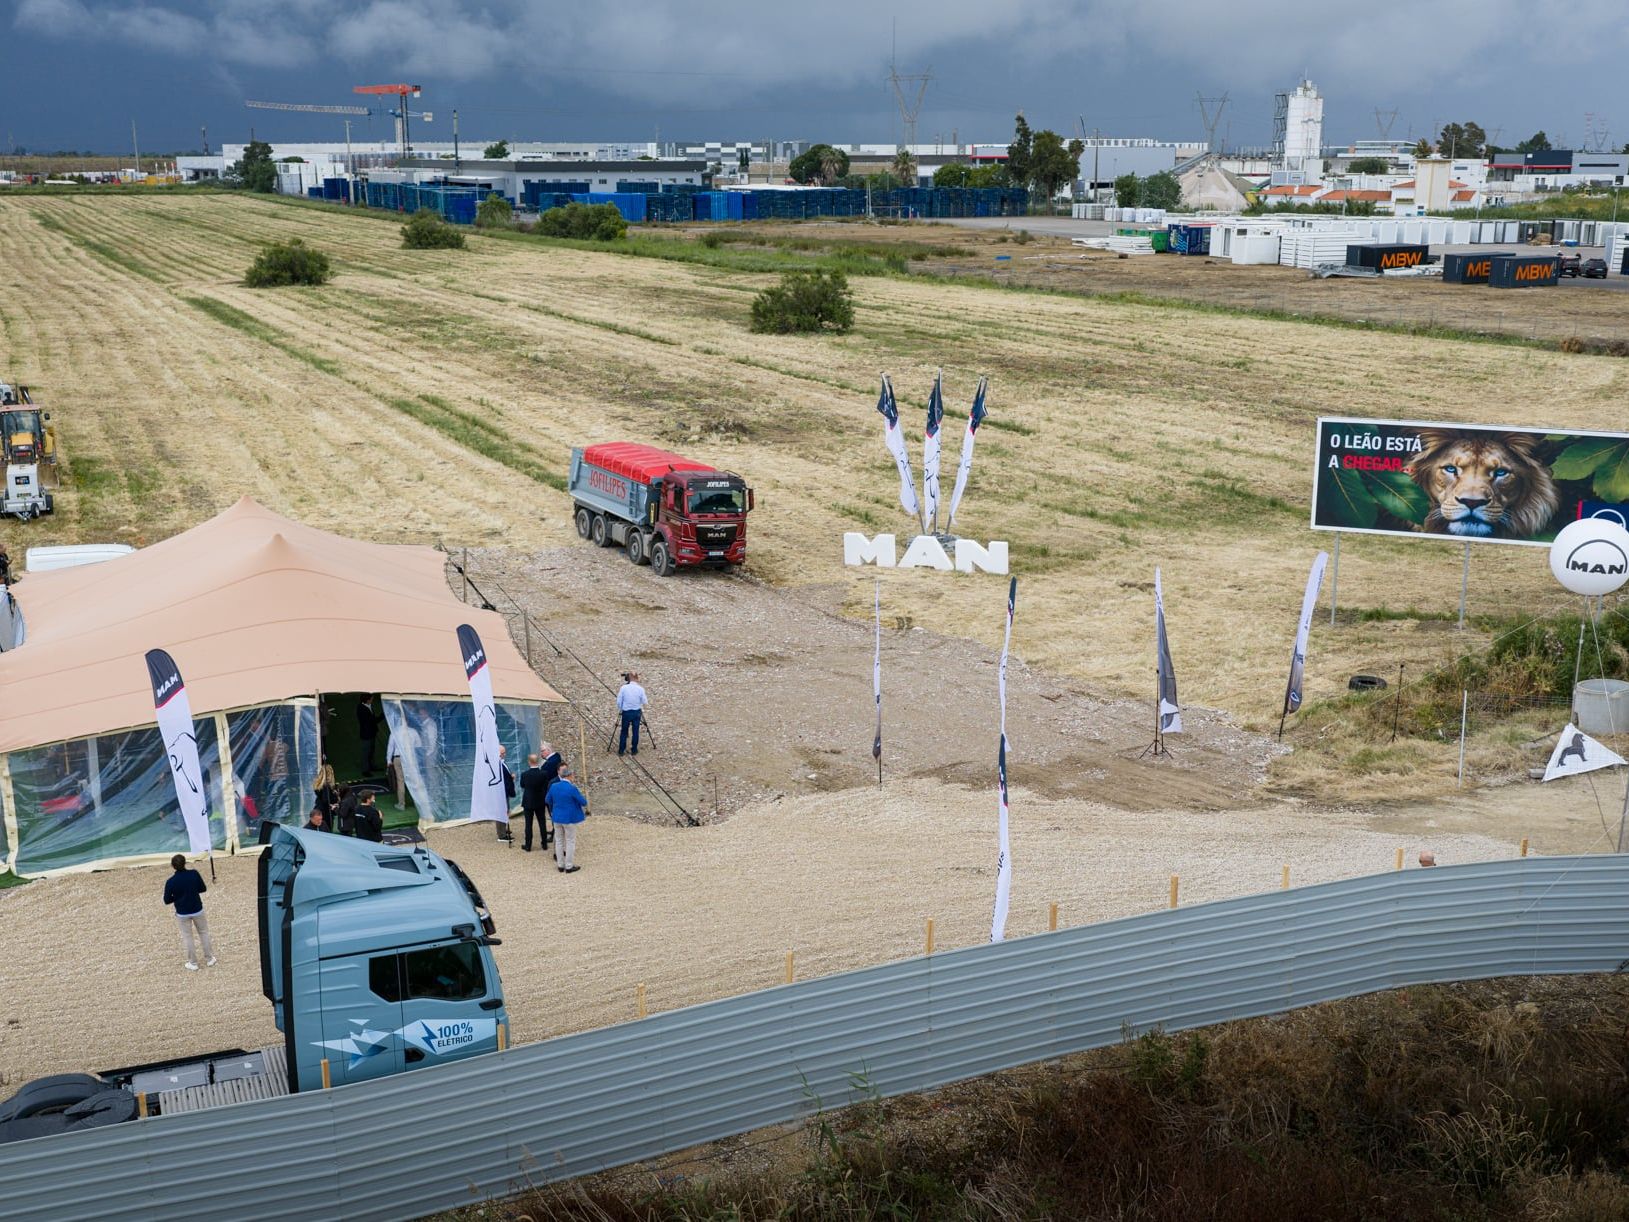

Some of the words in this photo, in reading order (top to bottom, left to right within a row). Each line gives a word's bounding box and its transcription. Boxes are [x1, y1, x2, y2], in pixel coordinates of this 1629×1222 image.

[1380, 251, 1422, 268] MBW
[1515, 263, 1554, 280] MBW
[1330, 434, 1340, 448] O
[1344, 432, 1382, 450] LEÃO
[1386, 434, 1422, 452] ESTÁ
[1328, 454, 1339, 468] A
[590, 469, 626, 499] JOFILIPES
[844, 532, 1009, 575] MAN
[1570, 560, 1625, 575] MAN
[437, 1021, 473, 1038] 100%
